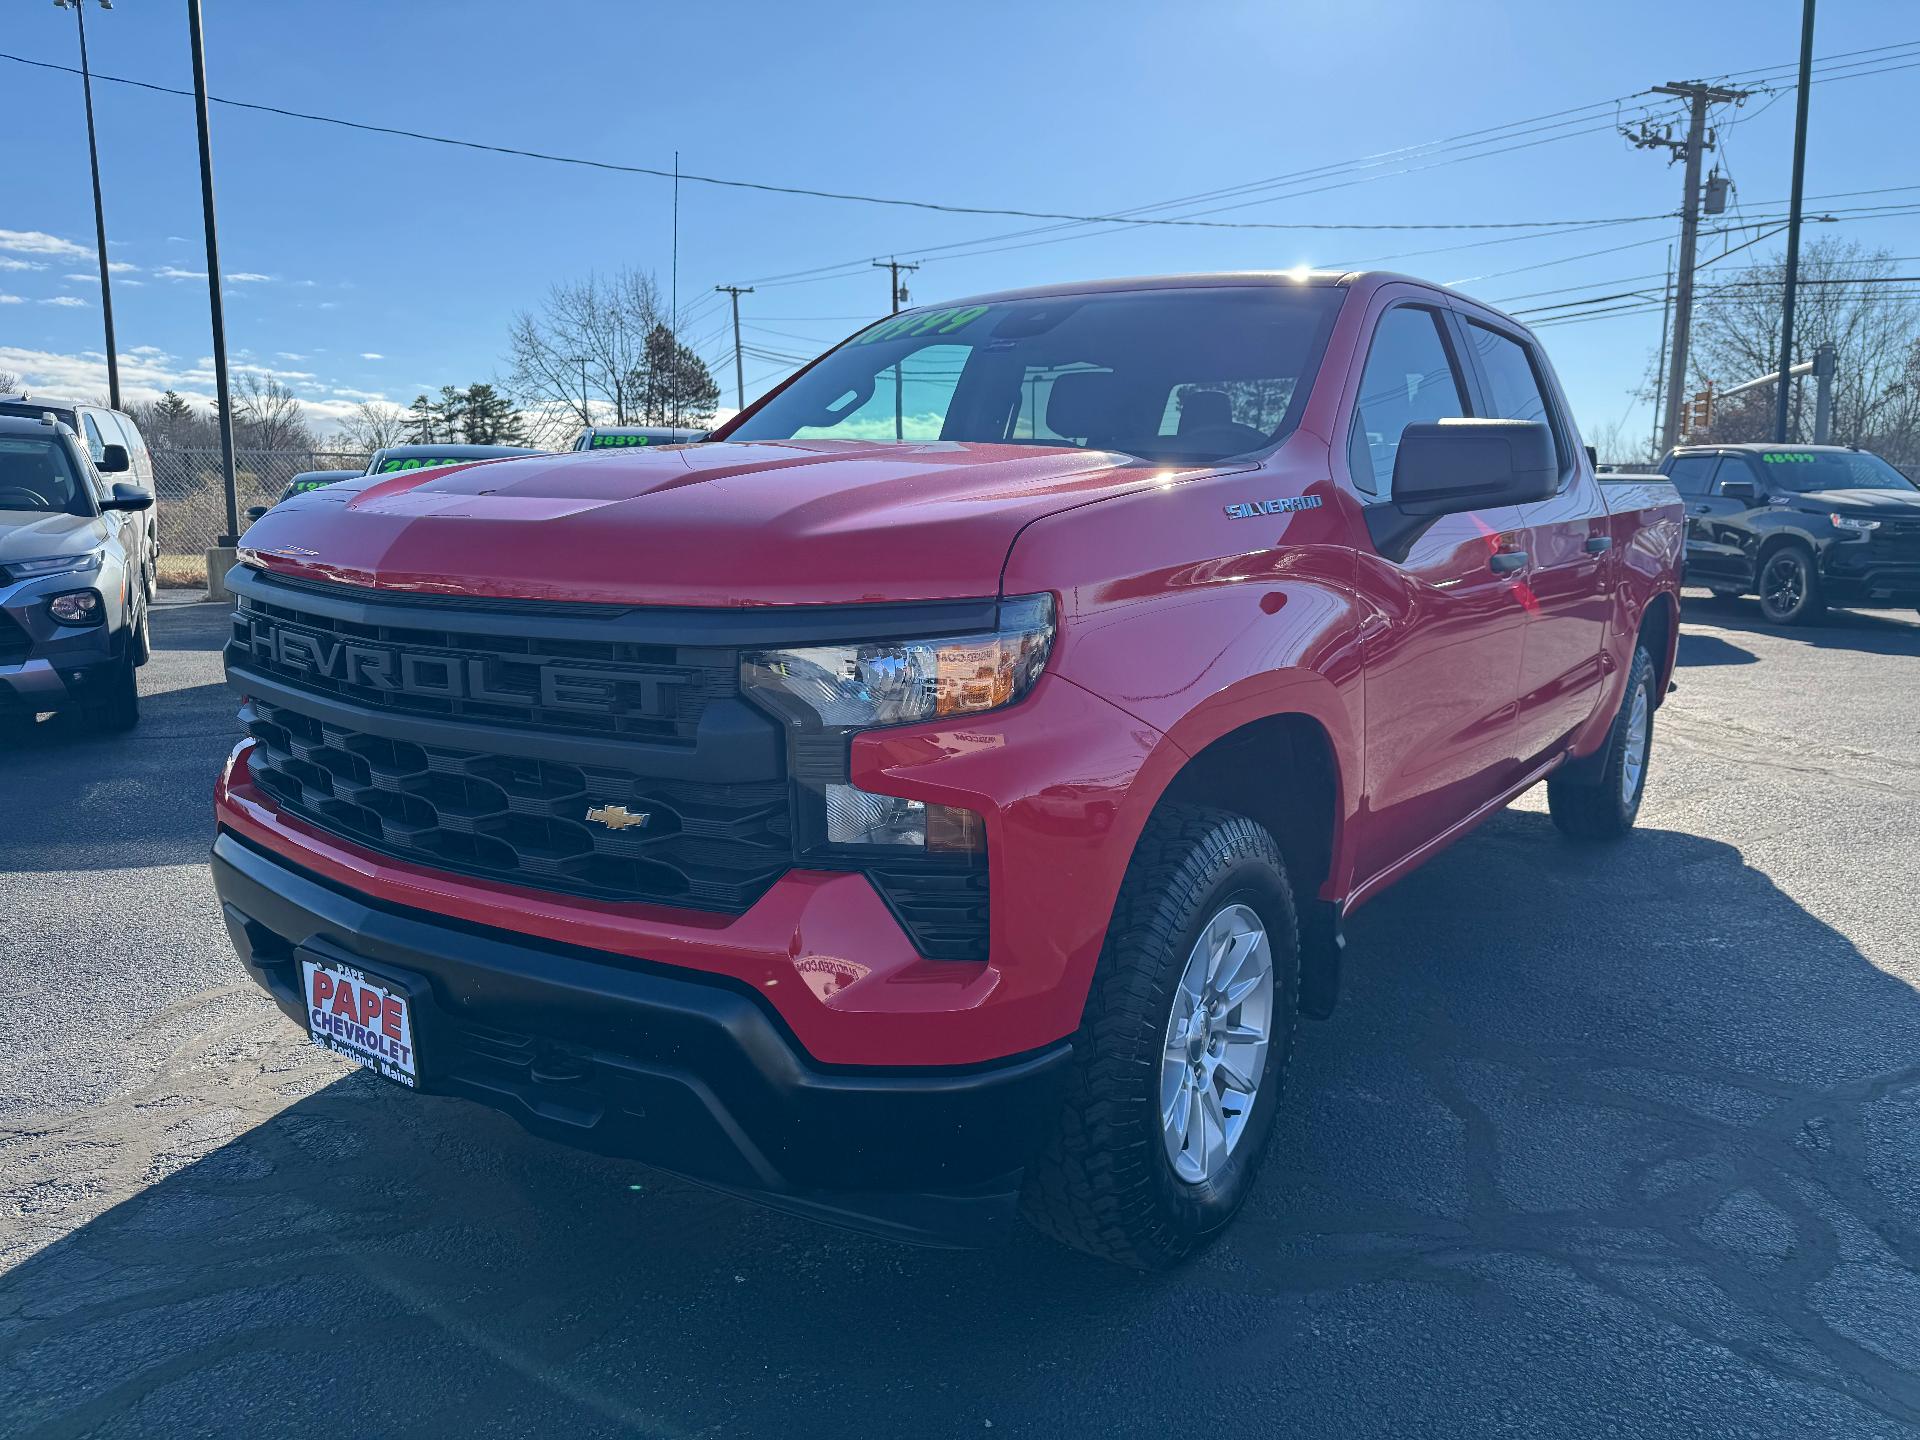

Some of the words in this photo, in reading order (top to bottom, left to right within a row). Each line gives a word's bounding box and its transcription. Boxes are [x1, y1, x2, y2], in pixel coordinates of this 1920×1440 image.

[593, 435, 649, 446] 38399
[1223, 495, 1323, 520] SILVERADO
[230, 611, 700, 716] CHEVROLET
[337, 964, 365, 981] PAPE
[312, 970, 402, 1041] PAPE
[311, 1009, 411, 1066] CHEVROLET
[381, 1062, 414, 1088] Maine
